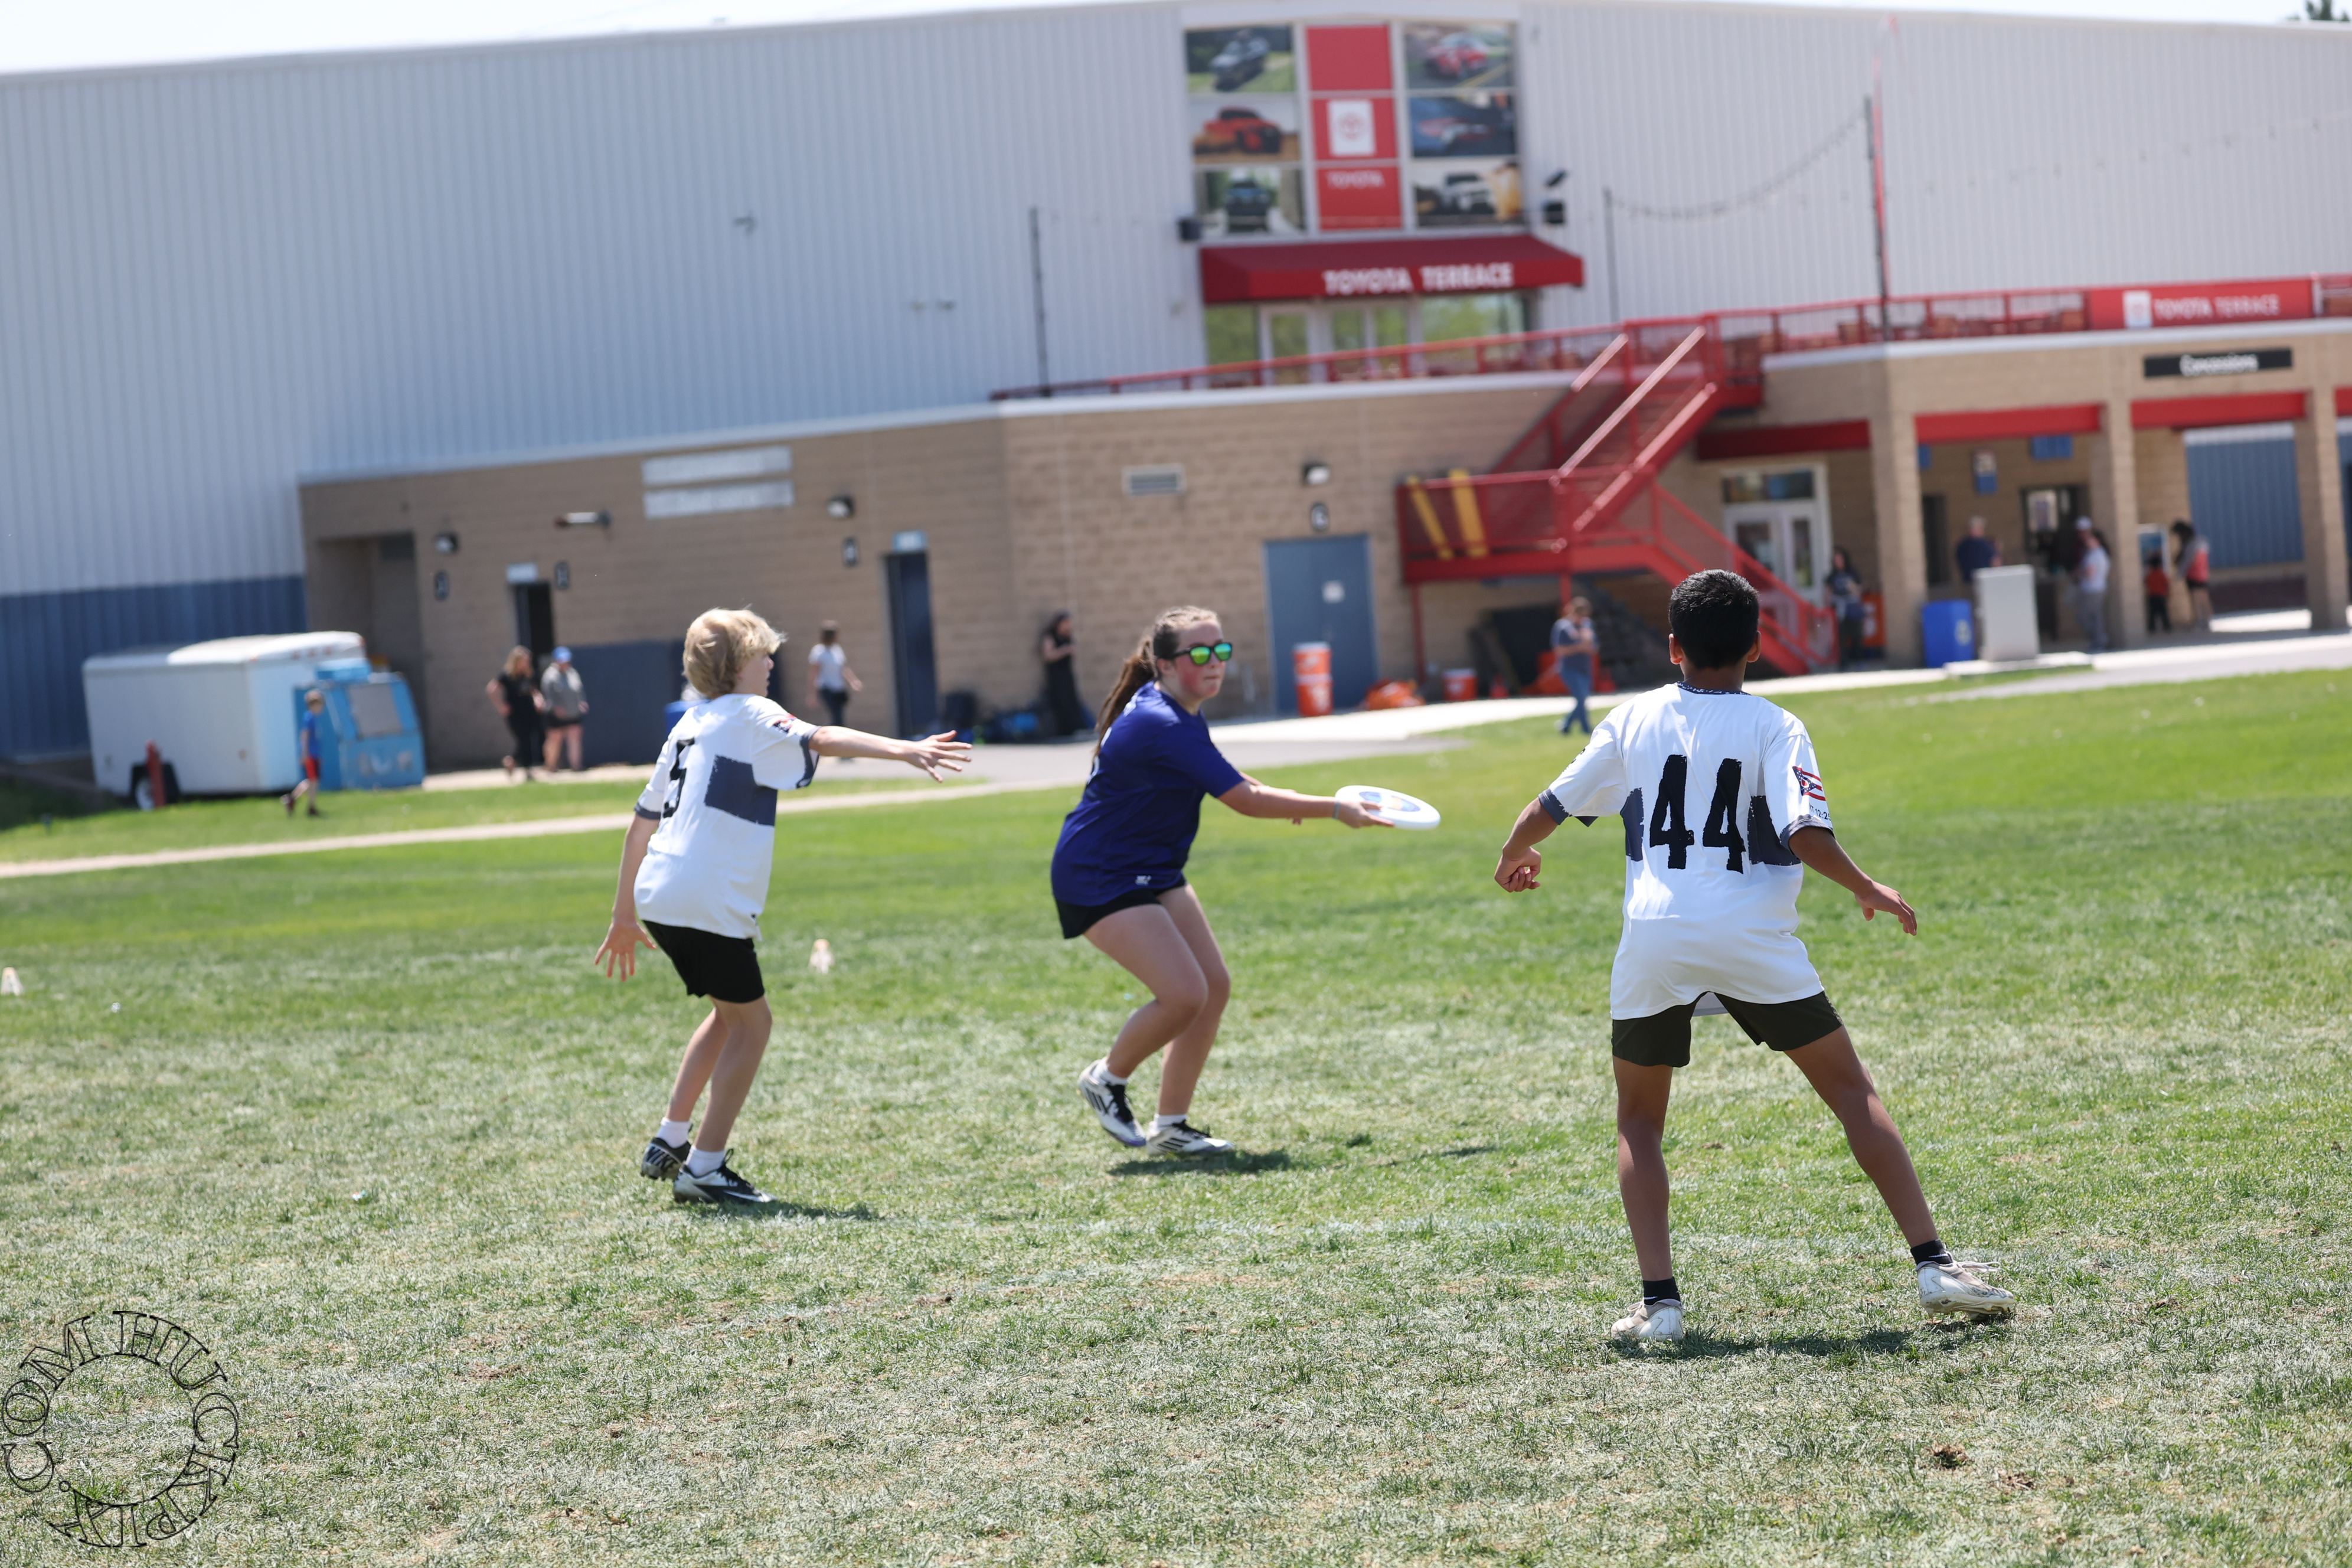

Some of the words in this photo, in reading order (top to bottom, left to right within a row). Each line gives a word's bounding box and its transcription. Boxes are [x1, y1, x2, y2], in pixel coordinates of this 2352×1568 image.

[1322, 267, 1415, 295] TOYOTA
[1420, 262, 1514, 290] TERRACE
[2154, 297, 2213, 319] TOYOTA
[2216, 294, 2280, 318] TERRACE
[663, 738, 695, 819] 5
[1649, 754, 1746, 874] 44
